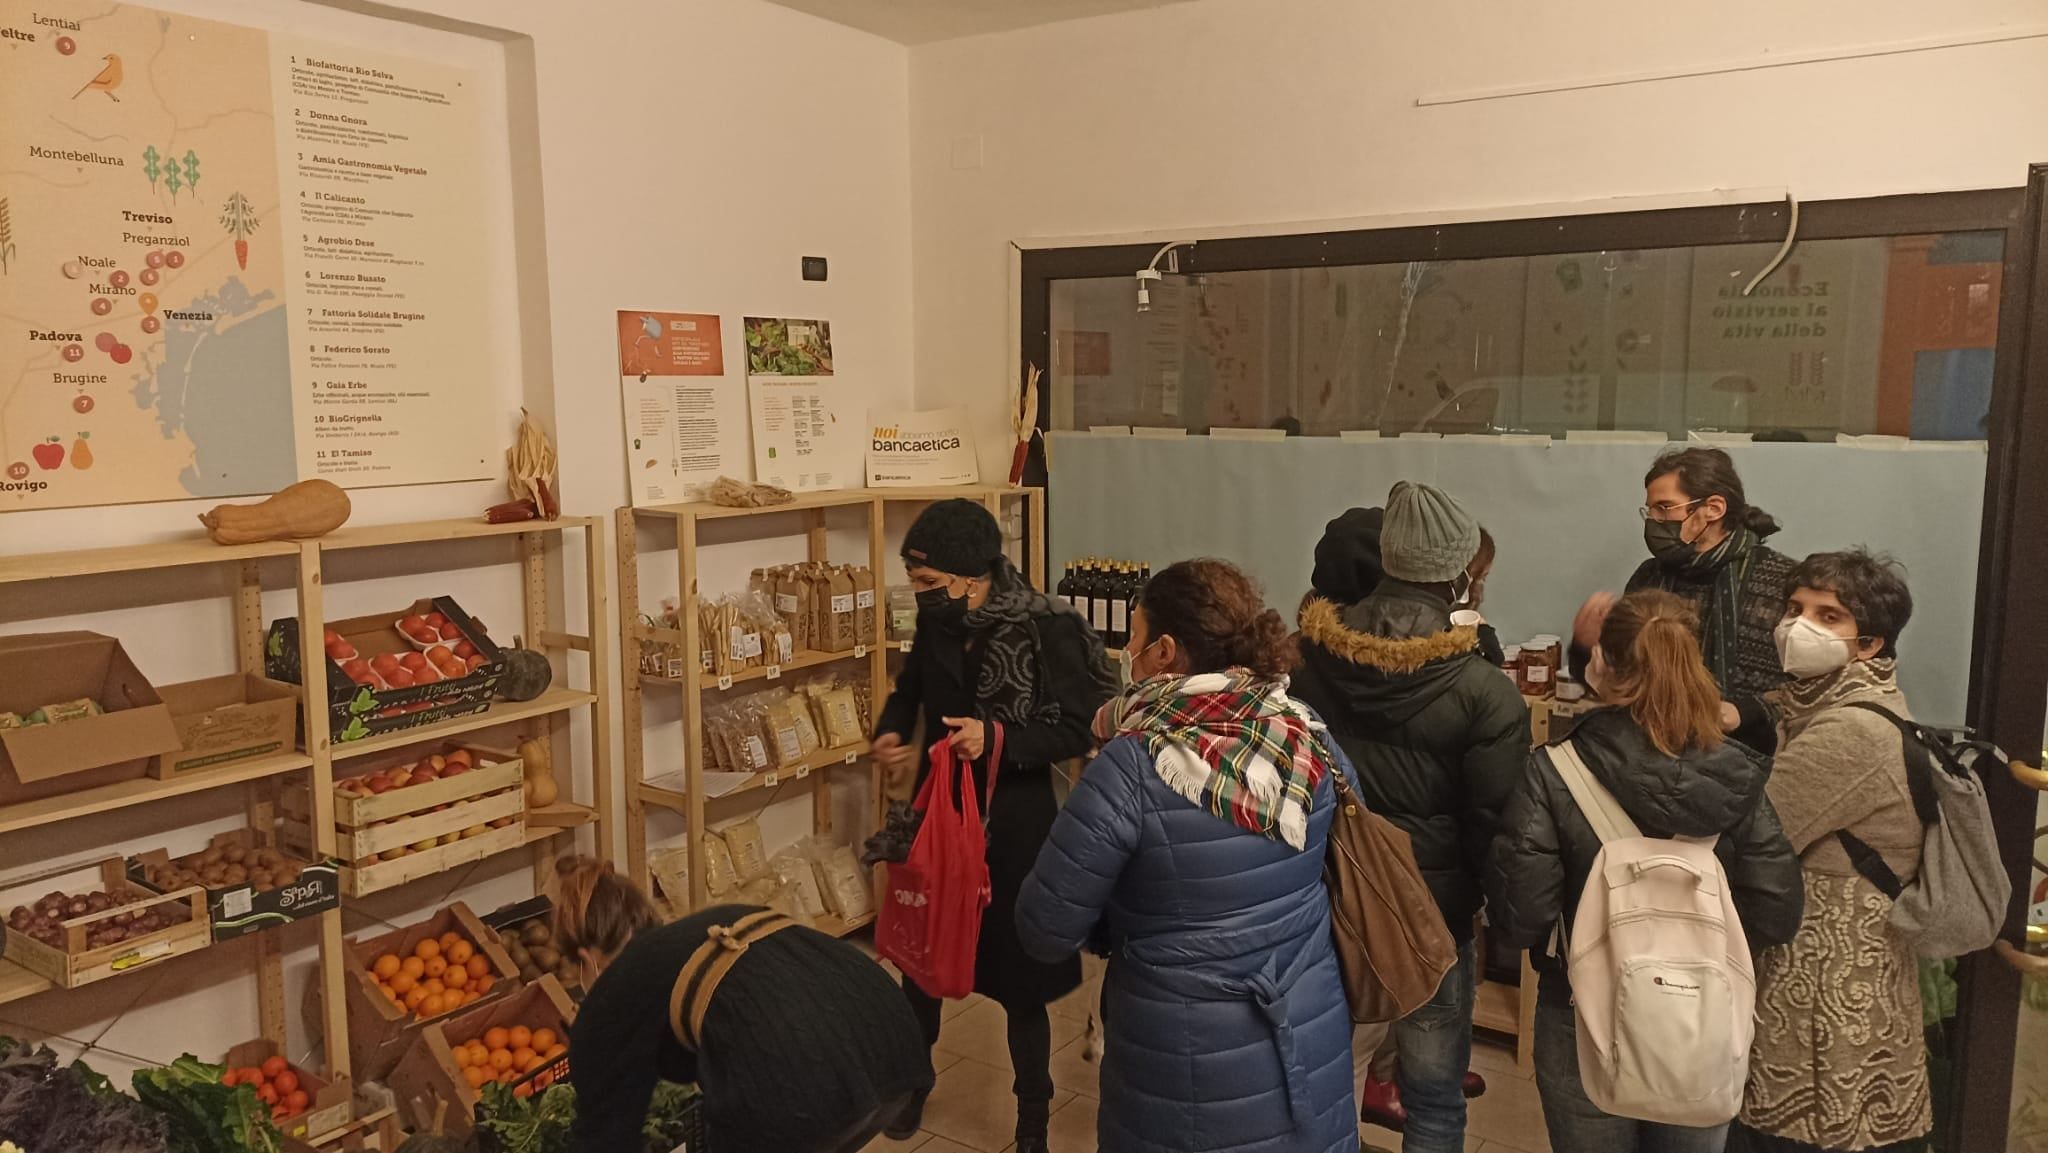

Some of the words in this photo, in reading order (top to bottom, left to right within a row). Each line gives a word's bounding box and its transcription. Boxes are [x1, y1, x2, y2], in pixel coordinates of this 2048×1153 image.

[32, 12, 81, 31] Lentiai
[0, 26, 36, 42] eltre
[306, 58, 354, 74] Biofattoria
[355, 67, 371, 77] Rio
[295, 108, 300, 116] 2
[309, 110, 339, 122] Donna
[341, 115, 368, 126] Gnora
[29, 145, 125, 167] Montebelluna
[313, 155, 336, 165] Amia
[338, 158, 392, 172] Gastronomia
[394, 165, 427, 177] Vegetale
[323, 193, 366, 205] Calicanto
[122, 210, 173, 225] Treviso
[122, 232, 190, 247] Preganziol
[317, 235, 353, 247] Agrobio
[355, 238, 375, 247] Dese
[78, 255, 117, 269] Noale
[320, 271, 356, 281] Lorenzo
[89, 283, 137, 296] Mirano
[163, 309, 213, 321] Venezia
[322, 309, 356, 318] Fattoria
[357, 310, 391, 319] Solidale
[393, 311, 425, 322] Brugine
[29, 330, 83, 342] Padova
[69, 348, 81, 358] 11
[324, 345, 362, 354] Federico
[53, 373, 107, 386] Brugine
[326, 382, 346, 390] Gaia
[348, 382, 367, 390] Erbe
[314, 415, 324, 424] 10
[873, 423, 899, 439] noi
[872, 437, 960, 452] bancaetica
[317, 451, 326, 459] 11
[342, 449, 372, 458] Tamiso
[14, 466, 26, 475] 10
